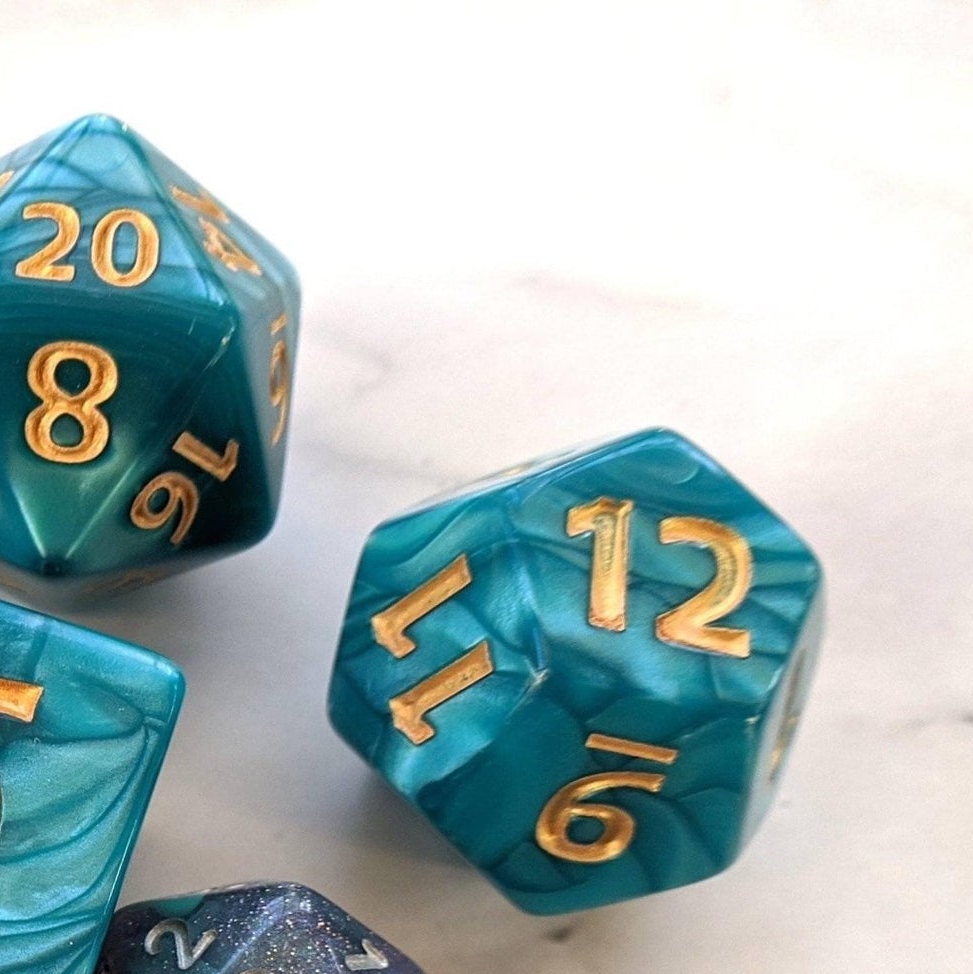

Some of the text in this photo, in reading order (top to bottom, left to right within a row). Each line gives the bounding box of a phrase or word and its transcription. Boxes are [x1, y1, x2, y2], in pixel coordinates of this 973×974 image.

[15, 202, 159, 288] 20
[24, 341, 119, 464] 8
[130, 430, 240, 546] 16
[566, 496, 754, 658] 12
[371, 553, 494, 745] 11
[144, 917, 219, 971] 2
